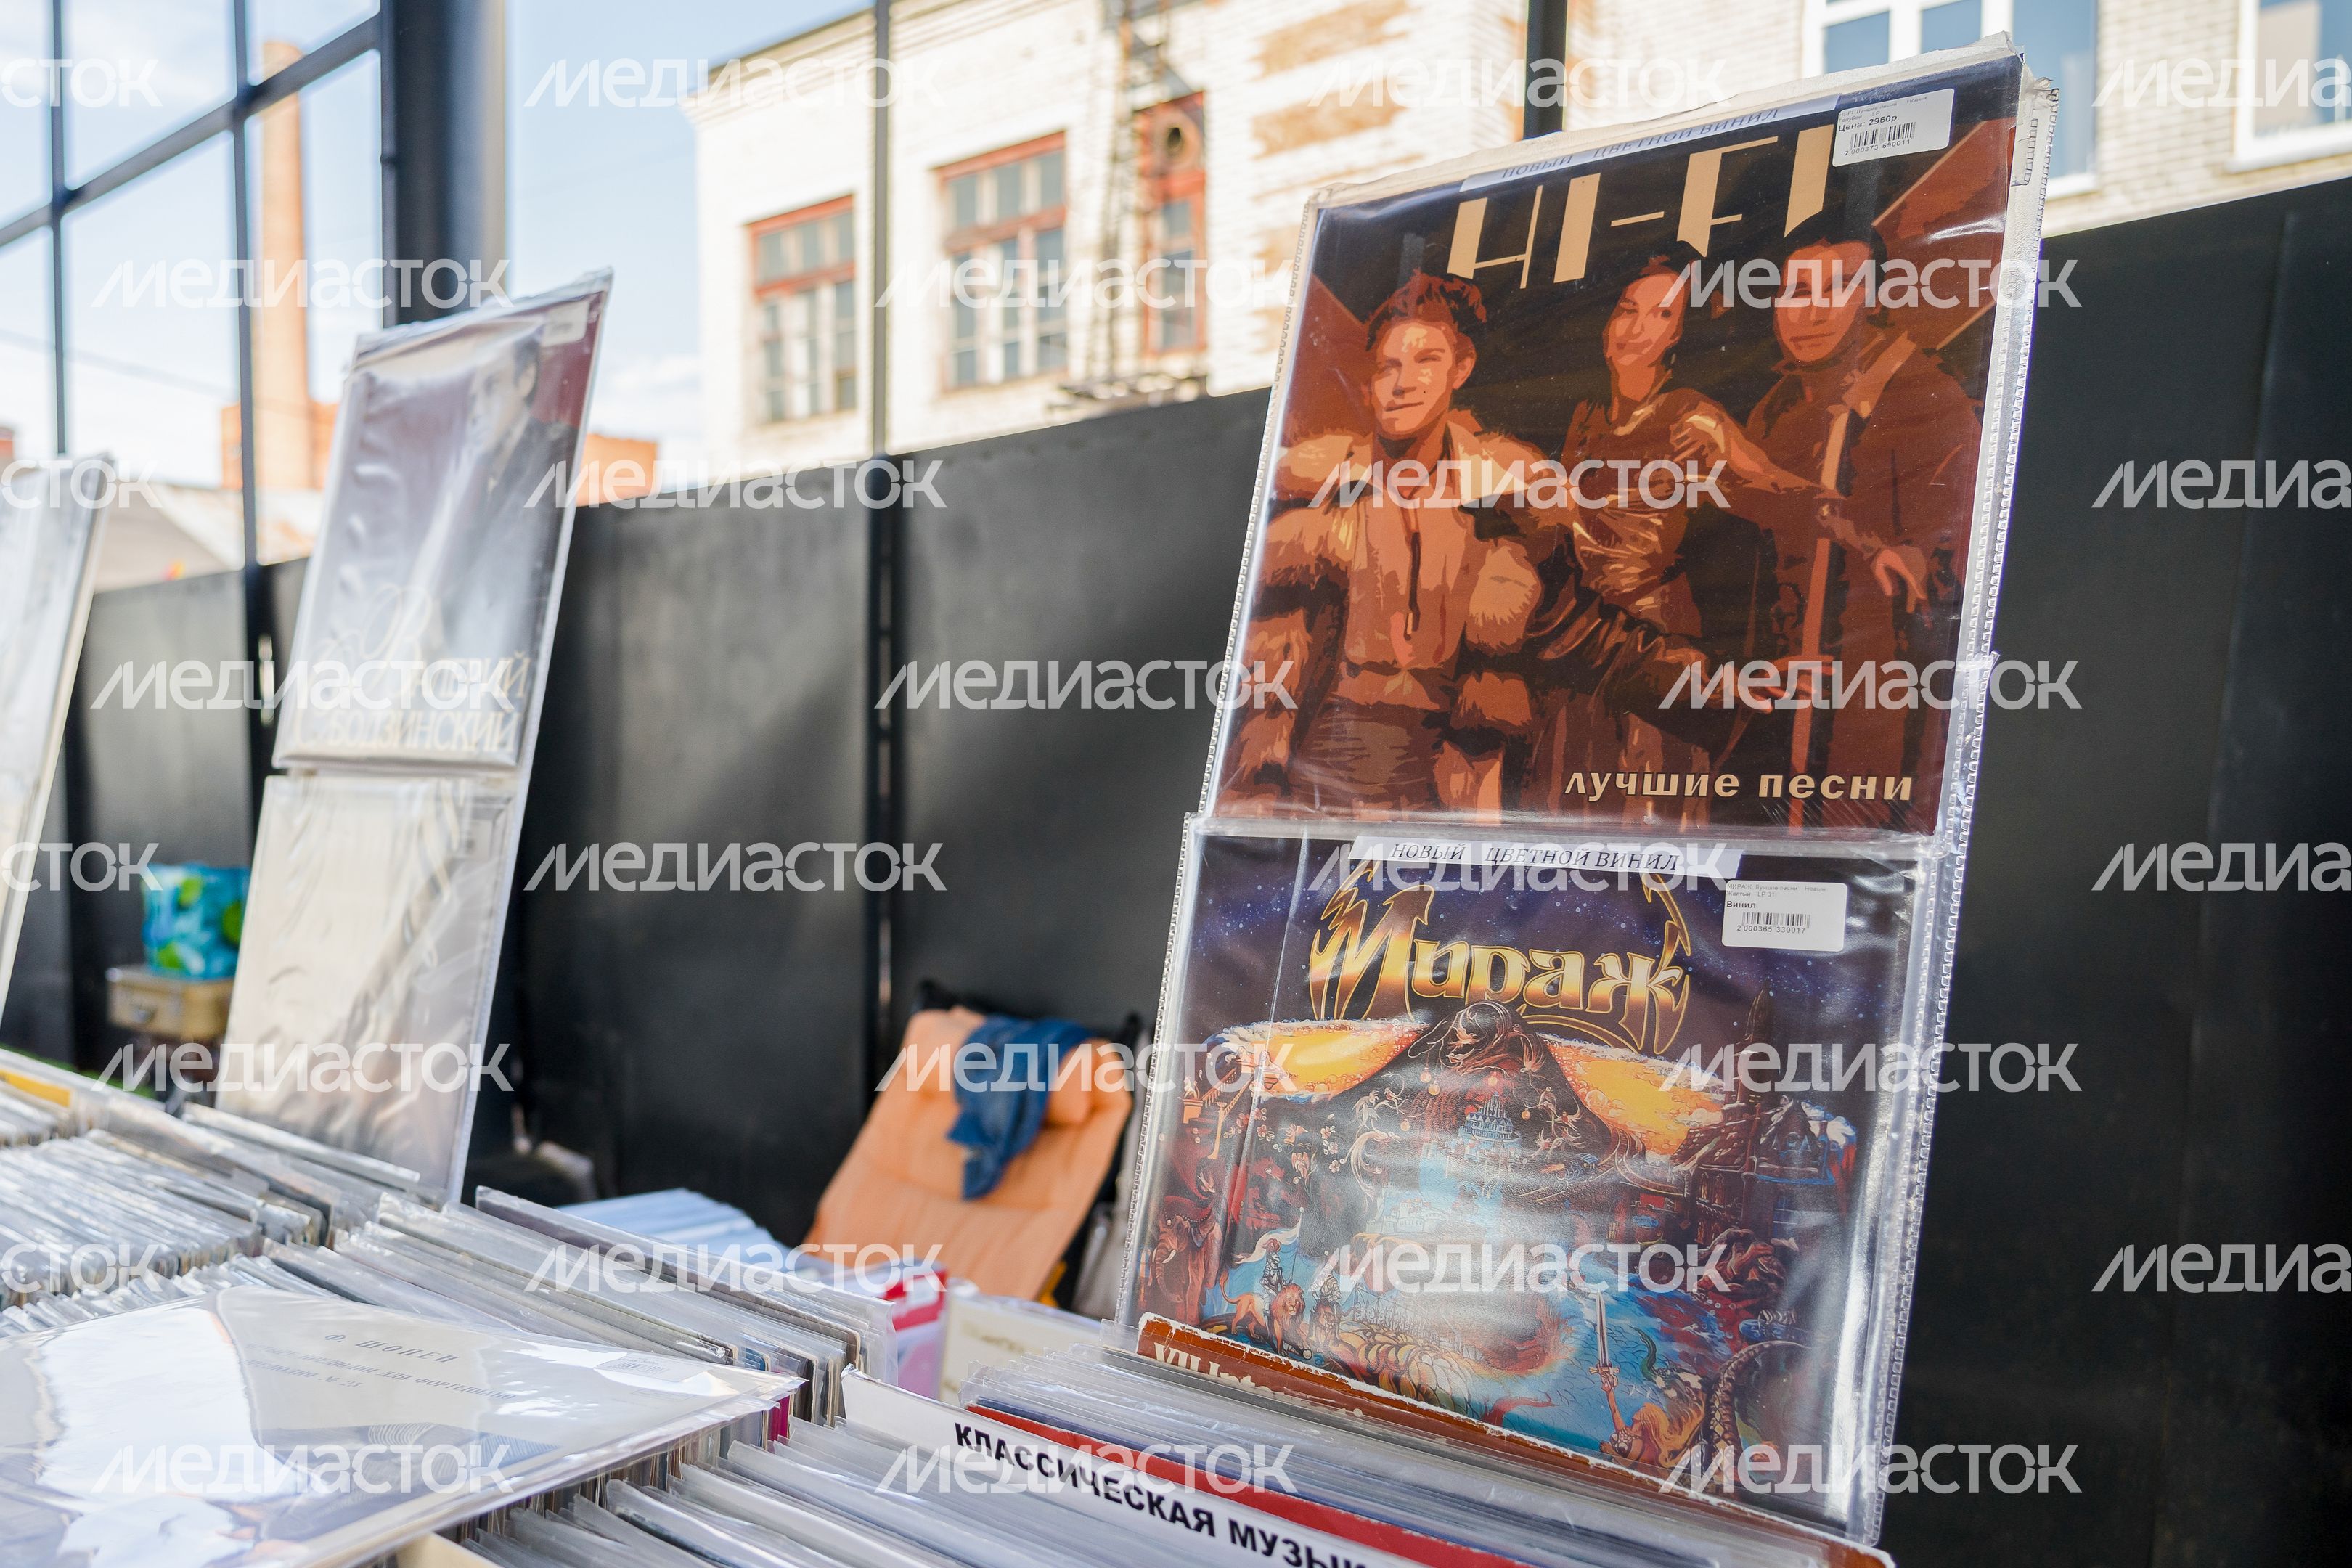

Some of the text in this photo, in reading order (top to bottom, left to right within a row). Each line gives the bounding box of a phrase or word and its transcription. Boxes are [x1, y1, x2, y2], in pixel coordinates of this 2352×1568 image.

[1838, 114, 1900, 133] Цена: 2950р.
[1501, 107, 1780, 179] НОВЫЙ ЦВЕТНОЙ ВИНИЛ
[1850, 144, 1879, 155] 000373
[1882, 137, 1911, 150] 690011
[1564, 772, 1913, 802] лучшие песни
[1389, 842, 1682, 871] НОВЫЙ ЦВЕТНОЙ ВИНИЛ
[1726, 900, 1756, 909] Винил
[1776, 926, 1806, 935] 330017
[1308, 860, 1691, 1055] Мираж
[354, 1339, 460, 1363] ШОПЕН
[953, 1421, 1367, 1568] КЛАССИЧЕСКАЯ МУЗЫ
